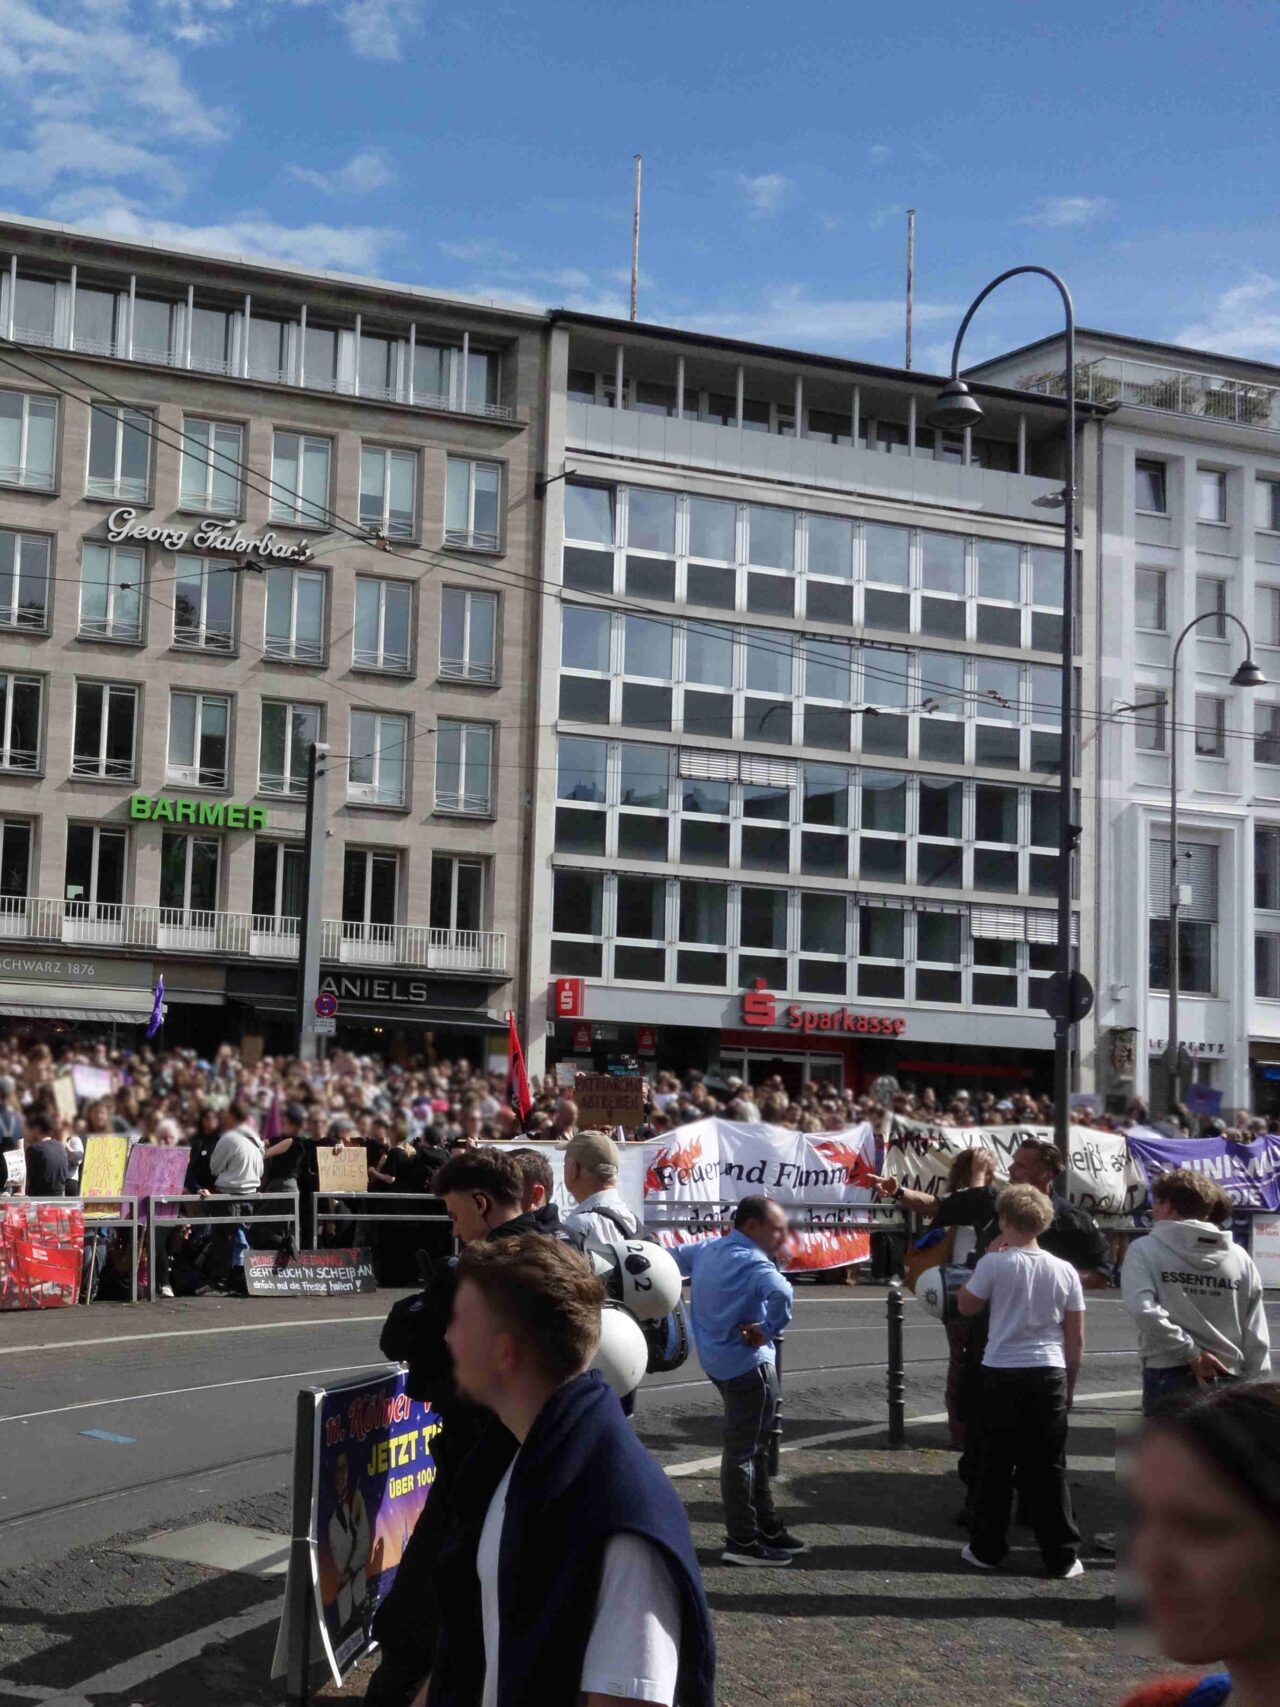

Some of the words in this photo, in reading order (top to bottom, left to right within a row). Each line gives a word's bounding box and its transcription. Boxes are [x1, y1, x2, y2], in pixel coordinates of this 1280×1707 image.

[107, 507, 188, 550] Georg
[130, 795, 268, 830] BARMER
[67, 962, 95, 976] 1876
[320, 976, 428, 1001] ANIELS
[786, 1004, 907, 1036] Sparkasse
[1149, 1038, 1225, 1053] LEPERTZ
[654, 1160, 720, 1191] Feuer
[249, 1268, 274, 1278] GEHT
[278, 1267, 302, 1279] EUCH
[253, 1280, 275, 1289] einfach
[277, 1280, 288, 1290] mal
[290, 1281, 300, 1289] die
[302, 1281, 327, 1291] Fresse
[329, 1280, 353, 1291] halten
[1161, 1271, 1241, 1291] ESSENTIALS
[366, 1430, 419, 1477] JETZT
[389, 1473, 414, 1499] ÜBER
